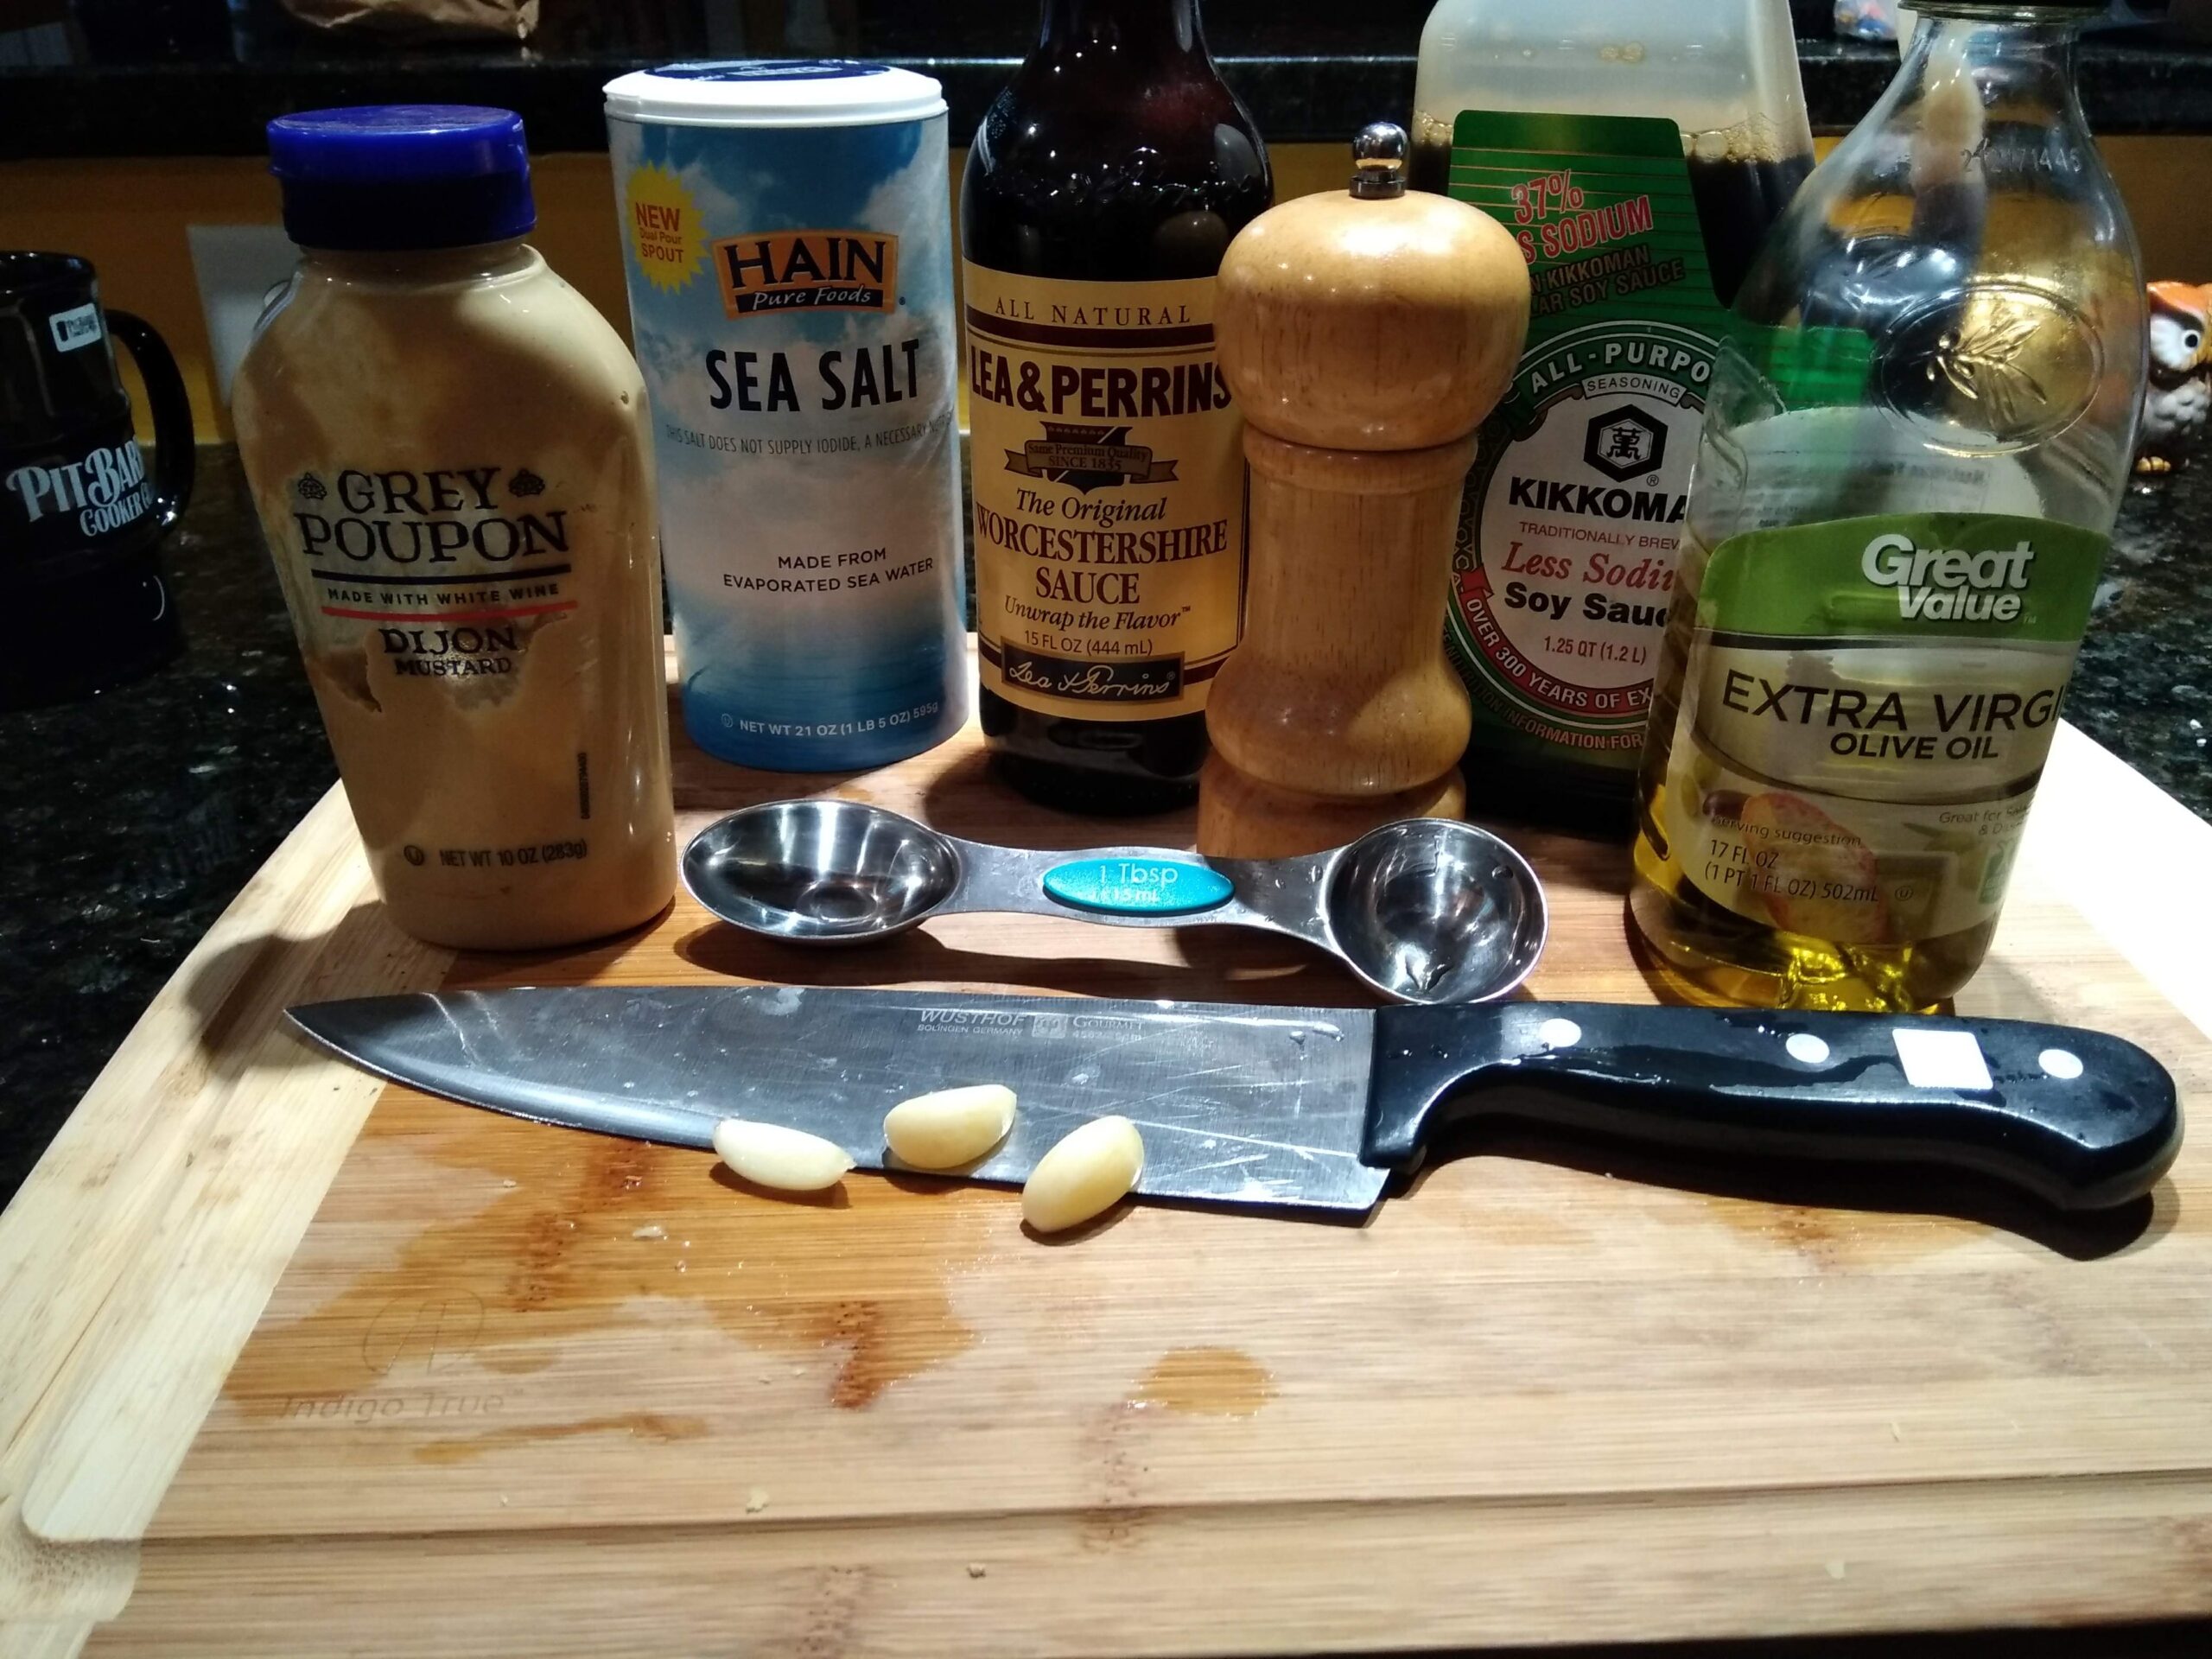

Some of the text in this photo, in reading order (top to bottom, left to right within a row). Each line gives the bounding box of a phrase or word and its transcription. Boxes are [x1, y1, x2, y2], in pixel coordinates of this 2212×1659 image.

[1512, 168, 1584, 226] 37%
[635, 202, 680, 232] NEW
[1541, 194, 1653, 257] SODIUM
[639, 227, 682, 245] Dual Pour
[641, 243, 683, 263] SPOUT
[724, 237, 887, 289] HAIN
[1548, 245, 1649, 289] KIKKOMAN
[753, 284, 871, 311] Pure Foods
[1570, 280, 1609, 306] SOY
[1617, 260, 1683, 294] SAUCE
[995, 296, 1191, 326] ALL NATURAL
[706, 339, 919, 412] SEA SALT
[1586, 377, 1681, 398] SEASONING
[684, 429, 705, 448] SALT
[709, 435, 737, 452] DOES
[741, 439, 763, 454] NOT
[768, 440, 811, 454] SUPPLY
[817, 437, 861, 454] IODIDE,
[865, 435, 872, 448] A
[876, 423, 926, 446] NECESSARY
[1028, 443, 1149, 462] Same Premium Quality
[1049, 456, 1122, 472] SINCE 1835
[338, 467, 501, 516] GREY
[80, 492, 144, 537] COOKER
[1016, 487, 1167, 528] The Original
[292, 510, 570, 563] POUPON
[976, 502, 1228, 564] WORCESTERSHIRE
[1520, 522, 1635, 546] TRADITIONALLY
[778, 547, 887, 569] MADE FROM
[1502, 541, 1572, 579] Less
[1861, 533, 2033, 590] Great
[723, 557, 934, 593] EVAPORATED SEA WATER
[1036, 566, 1141, 605] SAUCE
[327, 583, 560, 605] MADE WITH WHITE WINE
[1504, 581, 1572, 620] Soy
[1899, 585, 2023, 622] Value
[1005, 595, 1074, 632] Unwrap
[1078, 611, 1109, 629] the
[378, 626, 525, 655] DIJON
[1025, 629, 1153, 658] 15 FL OZ (444 mL)
[1466, 598, 1500, 647] OVER
[1496, 647, 1527, 677] 300
[1529, 671, 1587, 707] YEARS
[1595, 693, 1620, 709] OF
[1544, 636, 1647, 665] 1.25 QT (1.2 L)
[394, 658, 513, 678] MUSTARD
[1009, 660, 1052, 688] Lea
[1722, 670, 1908, 731] EXTRA
[740, 701, 938, 736] NET WT 21 OZ (1 LB 5 OZ) 595g
[1504, 708, 1607, 749] INFORMATION
[1611, 733, 1643, 749] FOR
[1830, 732, 1999, 760] OLIVE OIL
[1939, 812, 1980, 823] Great
[1775, 829, 1861, 846] suggestion
[439, 839, 588, 867] NET WT 10 OZ (283g)
[1711, 840, 1779, 869] 17 FL OZ
[1099, 863, 1179, 891] 1 Tbsp
[1705, 861, 1879, 901] (1 PT 1 FL OZ) 502mL
[973, 1027, 1023, 1036] GERMANY
[1073, 1015, 1145, 1030] GOURMET
[281, 1395, 405, 1424] Indigo
